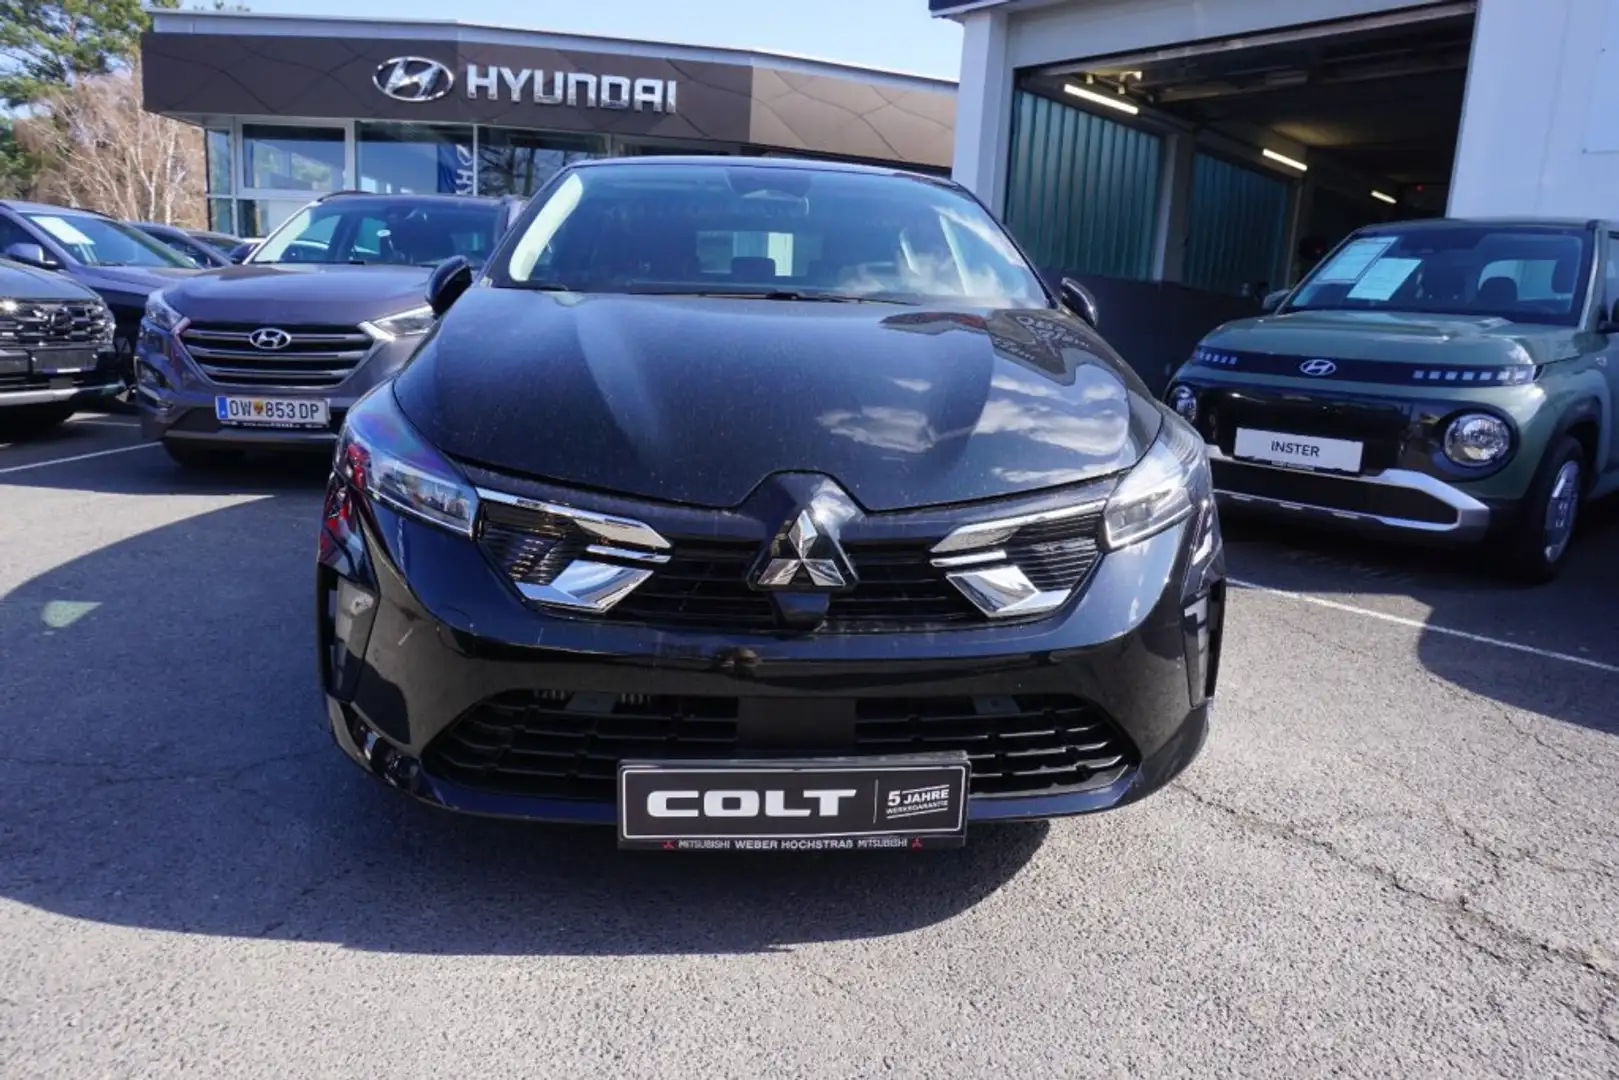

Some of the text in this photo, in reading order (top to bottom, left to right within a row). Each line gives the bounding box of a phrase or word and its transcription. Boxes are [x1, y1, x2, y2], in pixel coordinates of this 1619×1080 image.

[466, 64, 677, 114] HYUNDAI
[265, 401, 296, 419] 853
[299, 403, 319, 419] DP
[1271, 440, 1320, 457] INSTER
[647, 789, 857, 817] COLT
[887, 788, 950, 806] 5 JAHRE
[678, 840, 730, 849] MITSUBISHI
[735, 840, 778, 849] WEBER
[857, 838, 908, 848] MITSUBISHI
